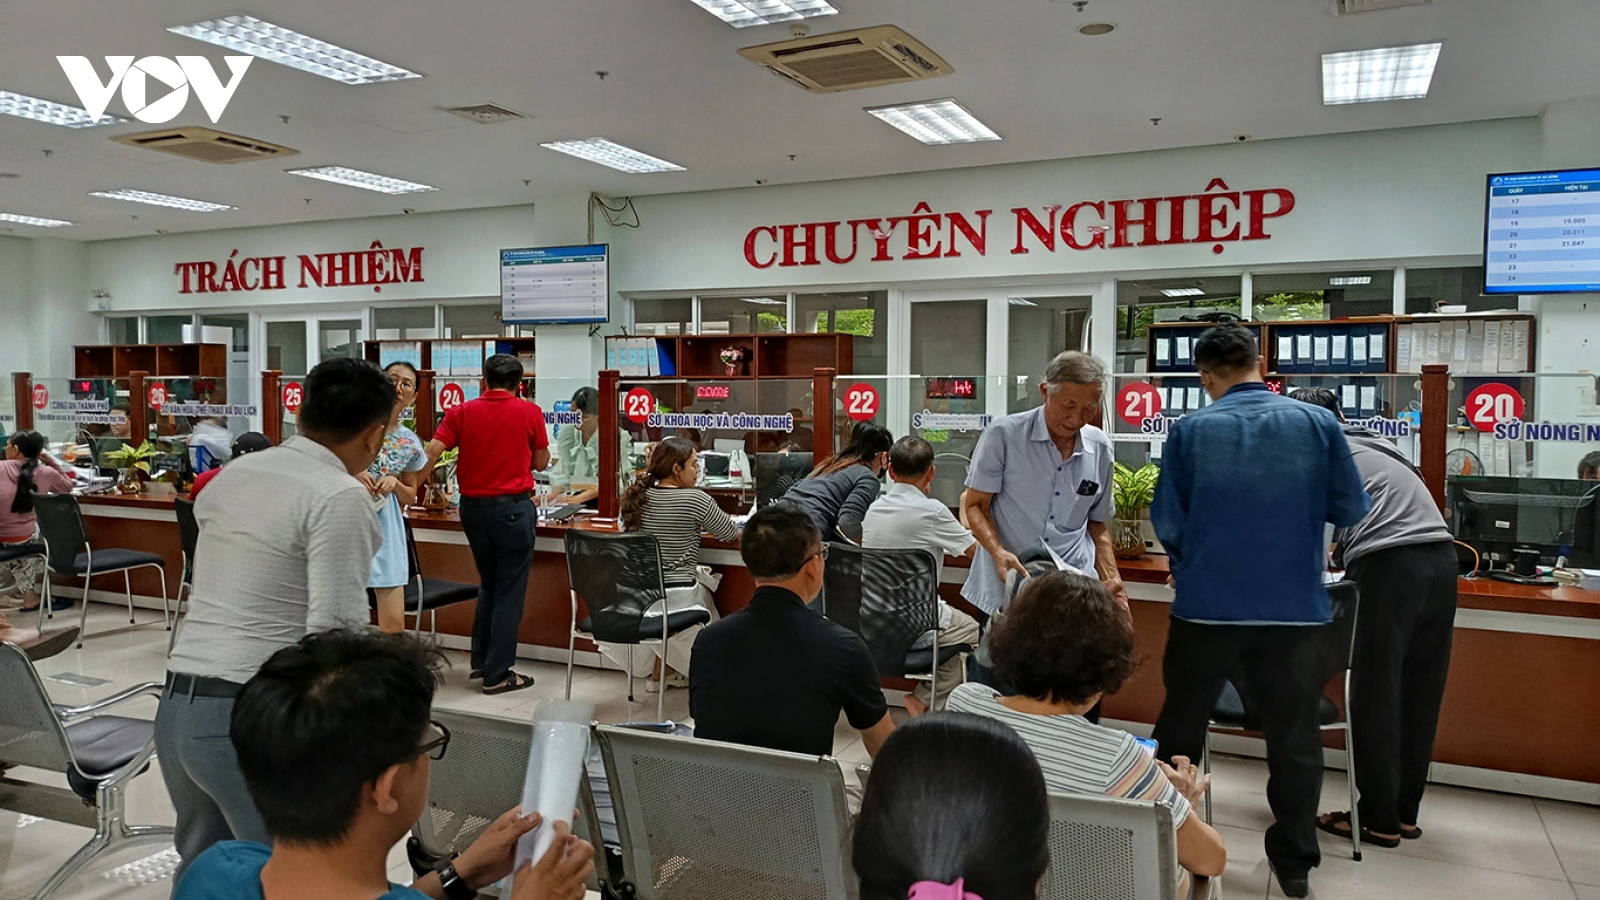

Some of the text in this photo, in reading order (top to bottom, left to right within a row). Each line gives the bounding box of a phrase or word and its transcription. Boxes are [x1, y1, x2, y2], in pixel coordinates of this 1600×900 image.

[743, 178, 1295, 269] CHUYÊN NGHIỆP
[173, 239, 425, 294] TRÁCH NHIỆM
[34, 389, 46, 405] 27
[151, 388, 165, 405] 26
[286, 388, 301, 406] 25
[443, 389, 461, 409] 24
[628, 395, 650, 416] 23
[848, 391, 875, 414] 22
[1124, 391, 1153, 417] 21
[557, 409, 582, 427] NGHỆ
[1474, 393, 1514, 423] 20
[648, 411, 793, 431] SỞ KHOA HỌC VÀ CÔNG NGHỆ
[1142, 413, 1164, 433] SỞ
[1495, 418, 1521, 440] SỞ
[1525, 420, 1580, 441] NÔNG
